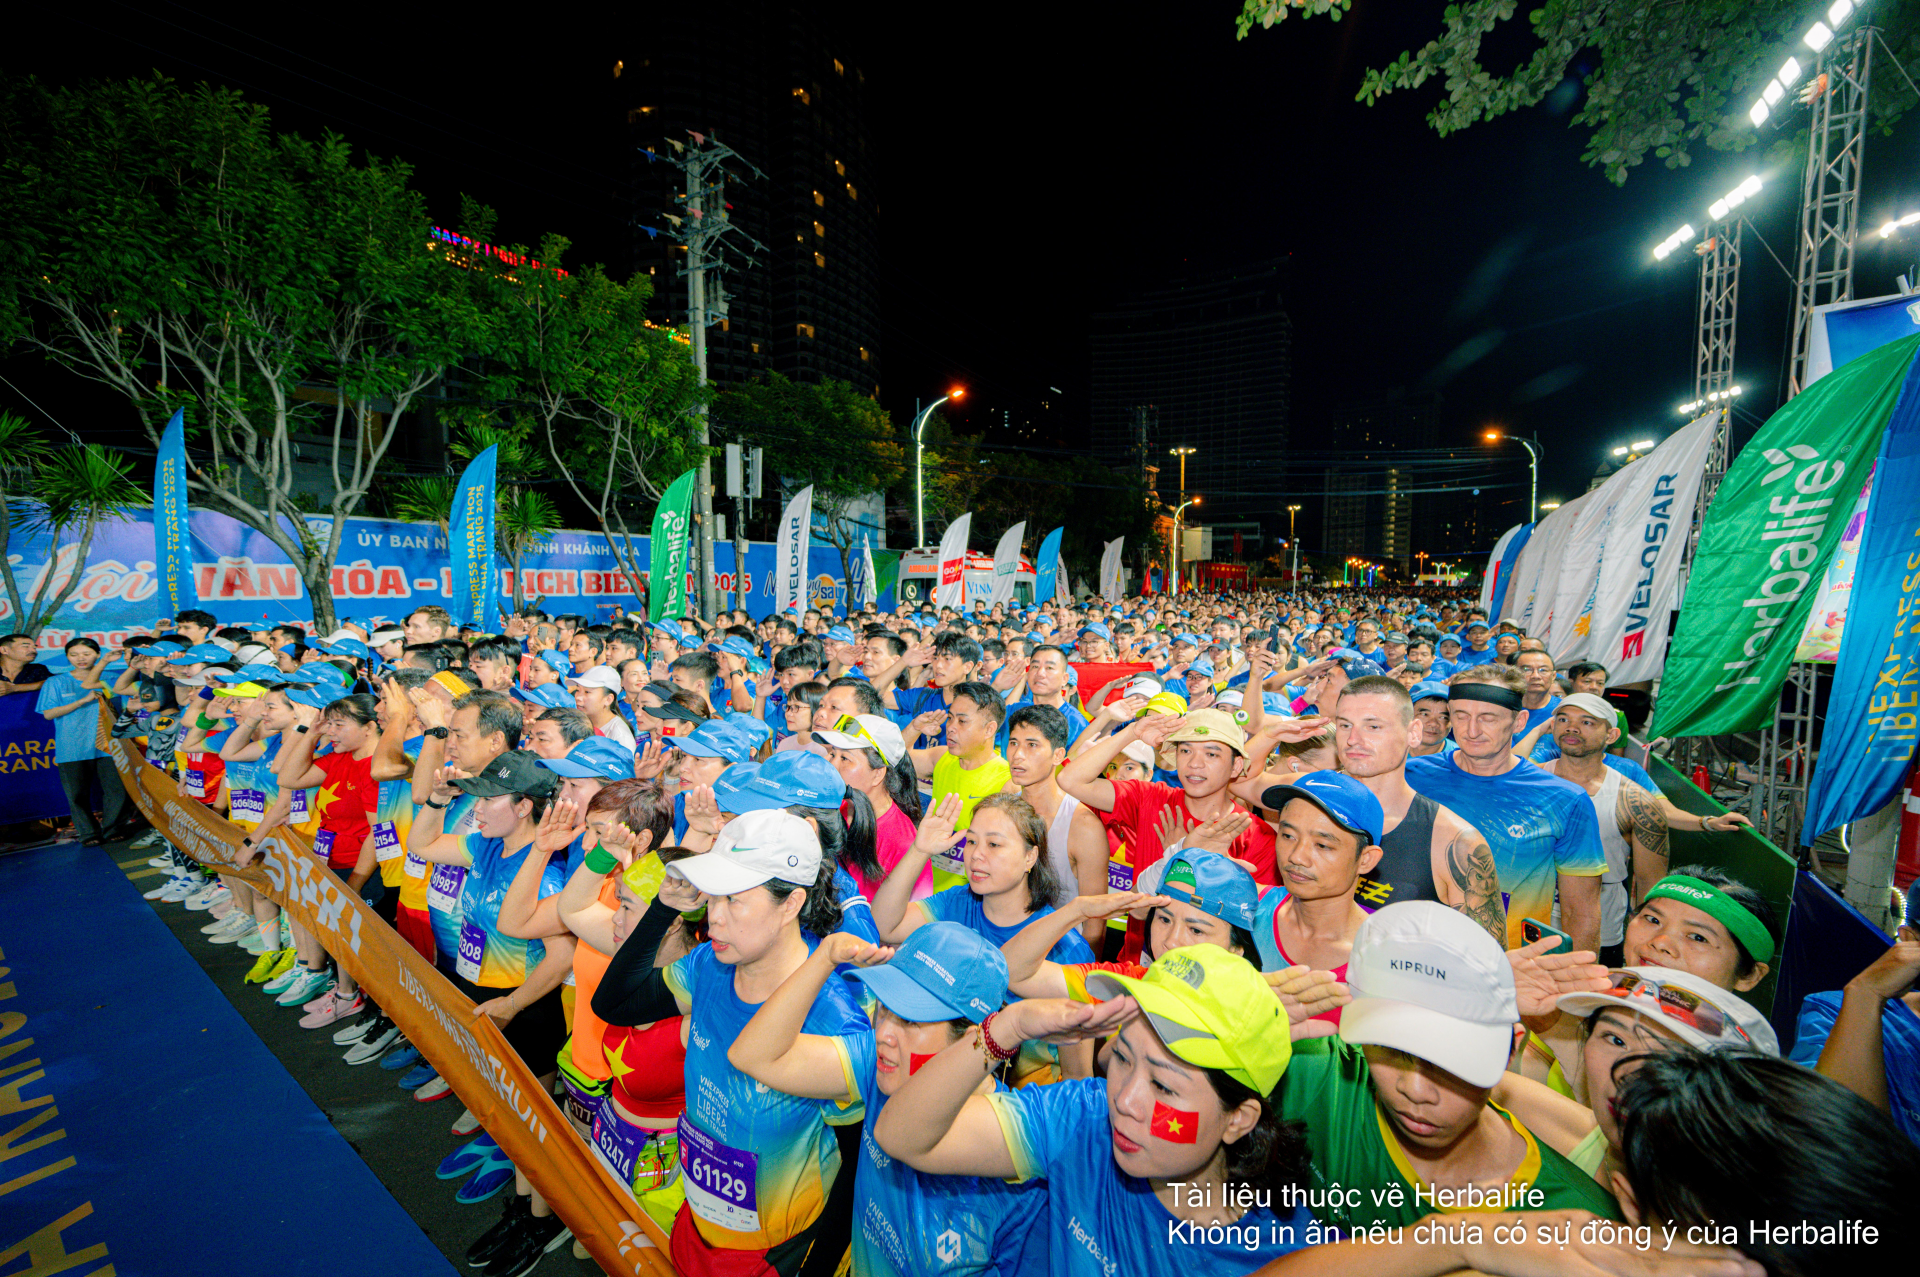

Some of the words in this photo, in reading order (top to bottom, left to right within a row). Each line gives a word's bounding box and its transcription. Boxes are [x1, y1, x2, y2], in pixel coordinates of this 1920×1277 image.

[475, 484, 485, 513] 2025
[358, 531, 385, 547] ỦY
[389, 535, 429, 549] BAN
[466, 486, 476, 559] MARATHON
[475, 516, 487, 560] TRANG
[563, 541, 610, 556] KHÁNH
[662, 516, 685, 618] Herbalife
[789, 516, 800, 602] VELOSAR
[1624, 471, 1679, 633] VELOSAR
[195, 560, 297, 597] VĂN
[329, 563, 406, 595] HÓA
[505, 570, 576, 599] LỊCH
[469, 562, 482, 622] NEXPRESS
[967, 581, 993, 595] VINM
[1715, 453, 1847, 692] Herbalife
[1390, 958, 1447, 981] KIPRUN
[698, 1084, 728, 1118] MARATHON
[700, 1074, 729, 1109] VNEXPRESS
[696, 1108, 709, 1126] NHA
[709, 1119, 728, 1142] TRANG
[600, 1131, 631, 1179] 62474
[692, 1157, 747, 1202] 61129
